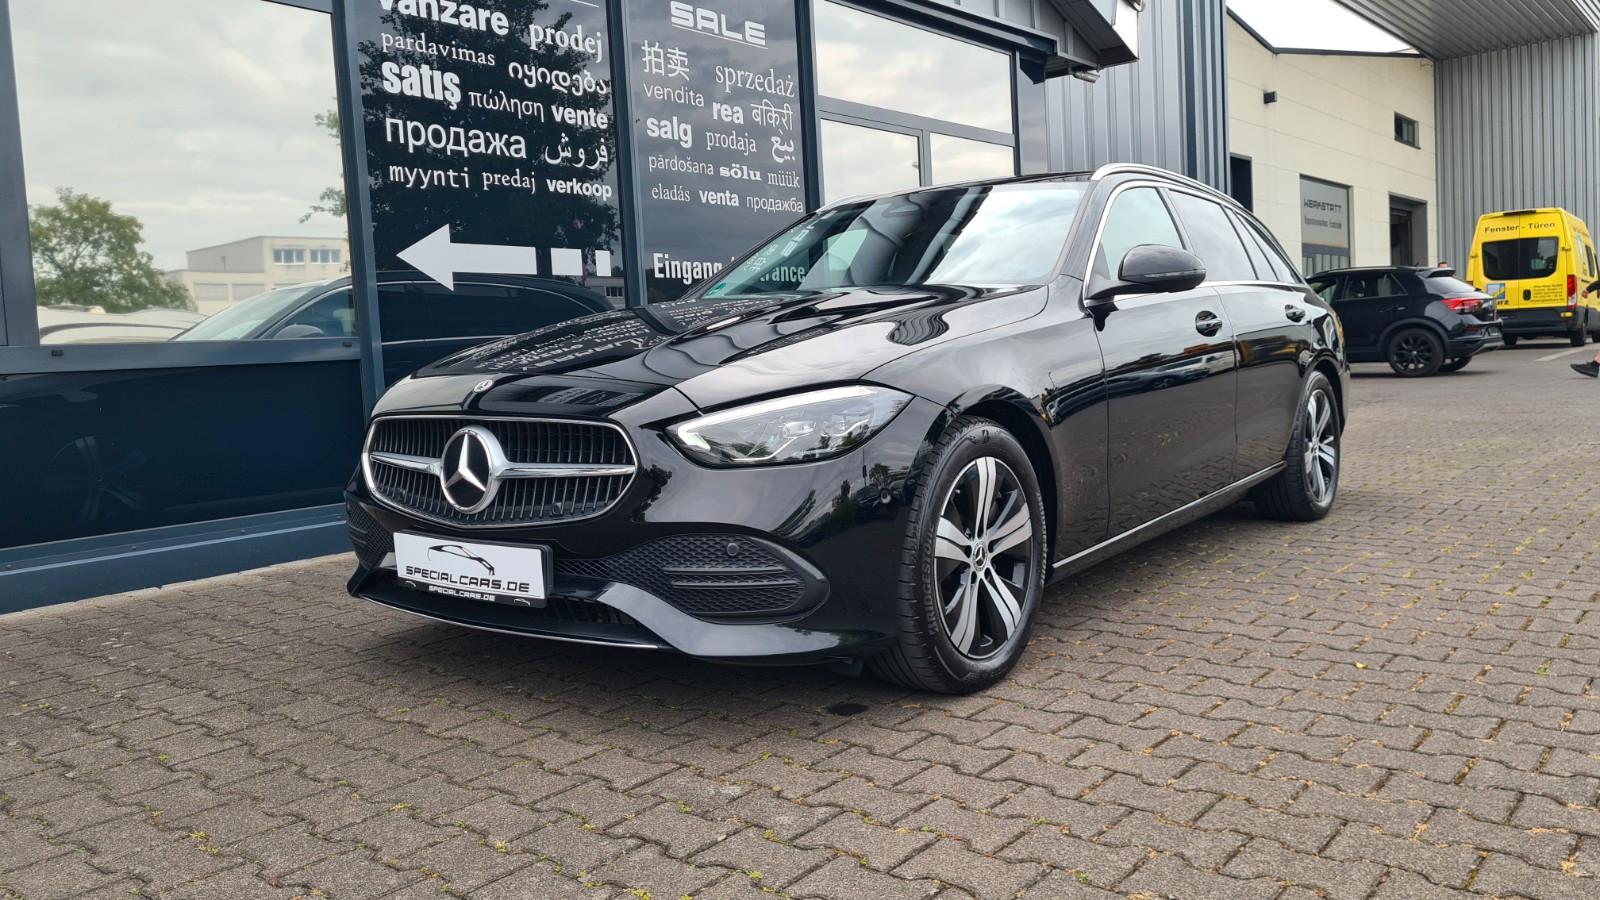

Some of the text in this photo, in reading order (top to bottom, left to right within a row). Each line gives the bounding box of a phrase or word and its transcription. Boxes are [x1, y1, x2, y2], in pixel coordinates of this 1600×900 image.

[670, 1, 766, 46] SALE
[381, 32, 496, 66] pardavimas
[529, 23, 602, 63] prodej
[641, 40, 690, 81] 拍卖
[381, 61, 462, 110] satış
[508, 61, 608, 96] იყიდება
[715, 65, 795, 98] sprzedaż
[468, 88, 544, 123] πώληση
[643, 84, 705, 108] vendita
[551, 105, 609, 130] vente
[712, 102, 745, 125] rea
[385, 117, 527, 159] продажа
[646, 116, 693, 149] salg
[705, 130, 757, 156] prodaja
[545, 132, 609, 170] فروش
[389, 165, 613, 200] myynti predaj verkoop
[649, 155, 801, 188] pārdošana sölu müük
[651, 184, 739, 207] eladás venta
[746, 197, 804, 213] продажба
[1484, 224, 1520, 233] Fenster
[1527, 222, 1555, 230] Türen
[405, 565, 531, 593] SPECIALCARS.DE
[428, 584, 496, 602] SPECIALCARS.DE
